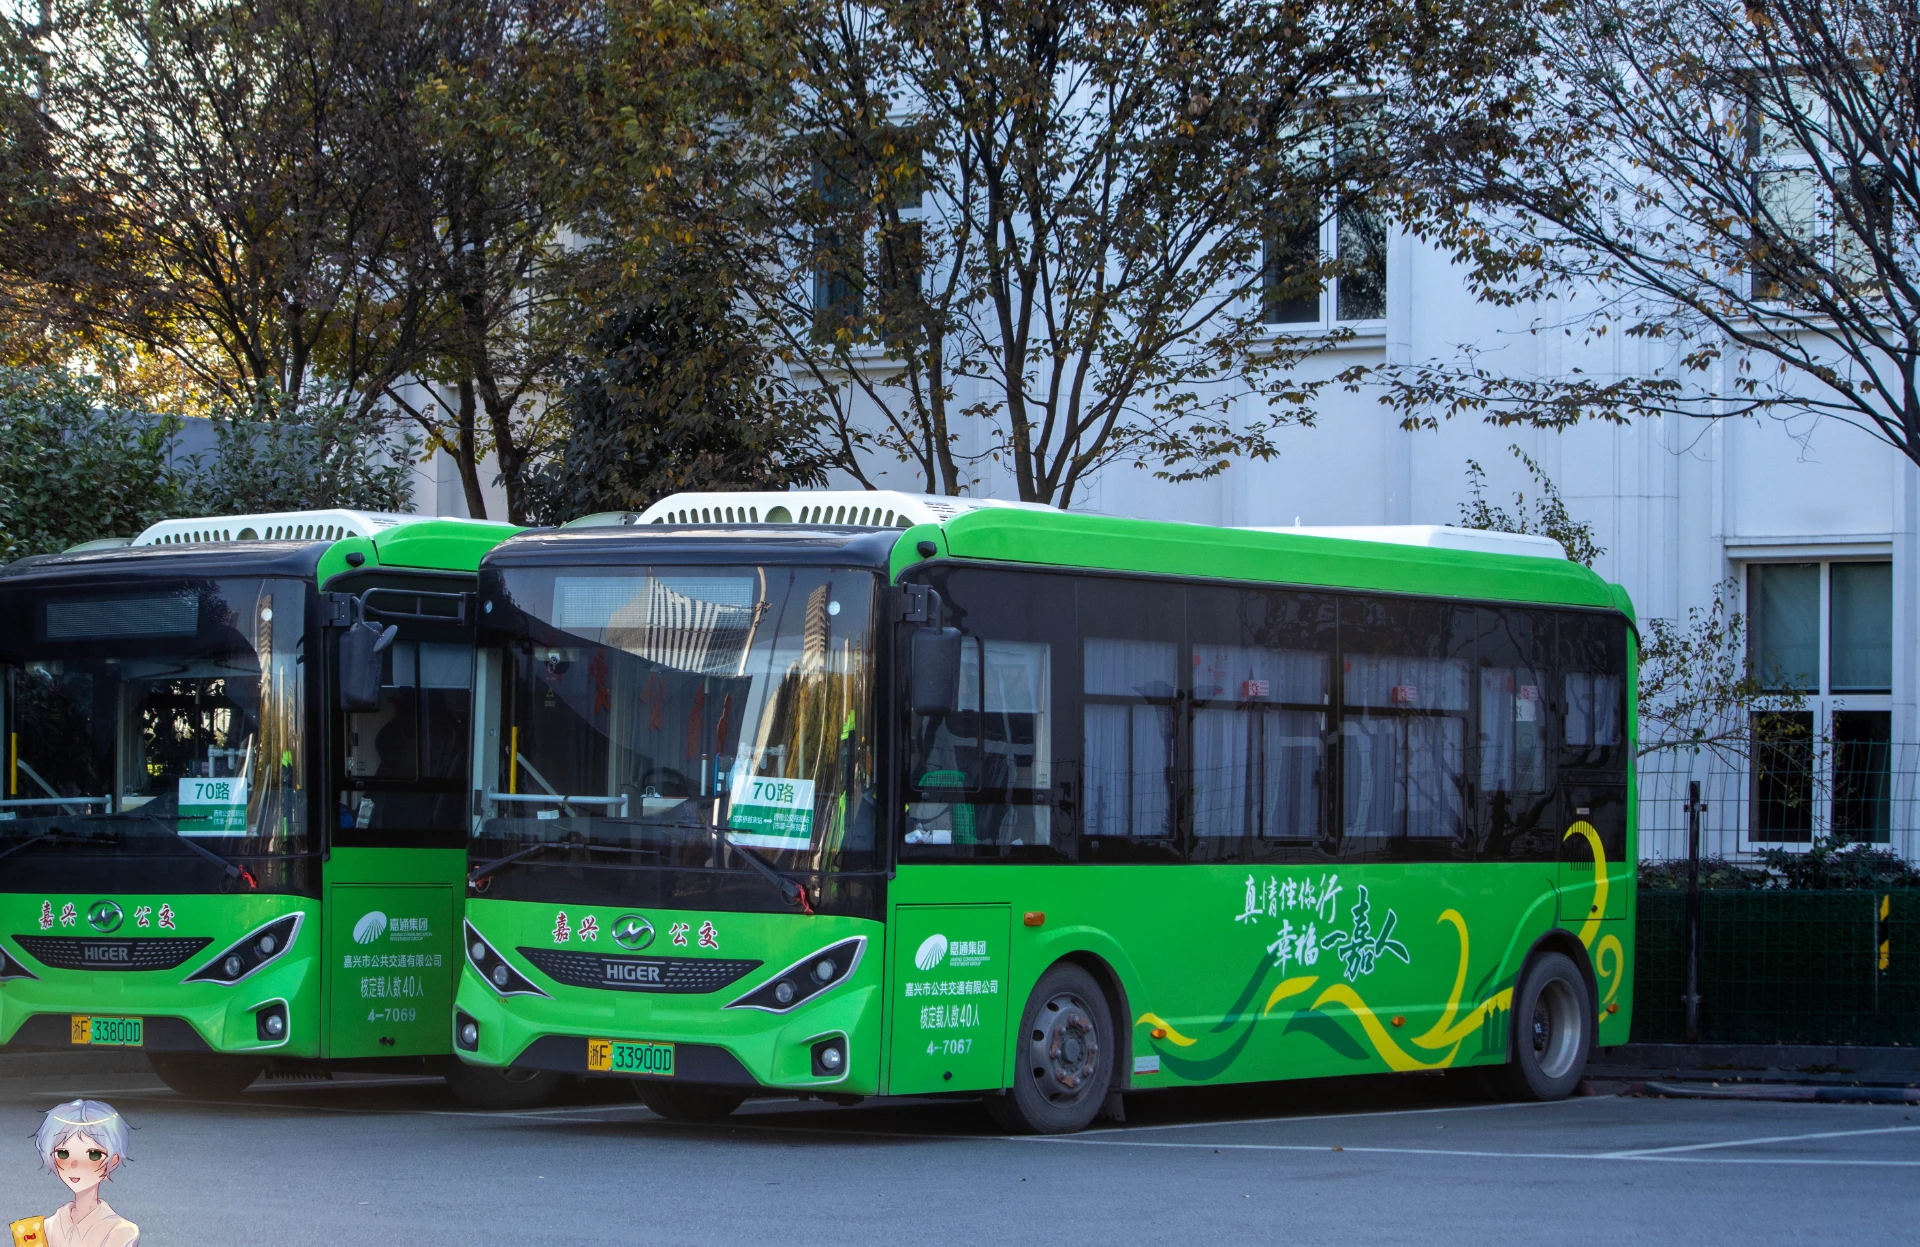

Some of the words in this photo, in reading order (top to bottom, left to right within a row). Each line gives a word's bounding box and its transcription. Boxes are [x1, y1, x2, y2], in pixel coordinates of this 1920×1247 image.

[195, 782, 230, 800] 70路
[753, 782, 794, 803] 70路
[1235, 873, 1343, 924] 真情伴你行
[38, 900, 78, 931] 嘉兴
[133, 903, 176, 930] 公交
[389, 917, 428, 932] 嘉通集团
[552, 911, 600, 943] 嘉兴
[668, 920, 719, 950] 公交
[84, 946, 129, 961] HIGER
[950, 941, 987, 956] 嘉通集团
[343, 954, 442, 968] 嘉兴市公共交通有限公司
[606, 964, 660, 982] HIGER
[905, 980, 998, 997] 嘉兴市公共交通有限公司
[367, 1008, 416, 1023] 4-7069
[926, 1039, 973, 1056] 4-7067
